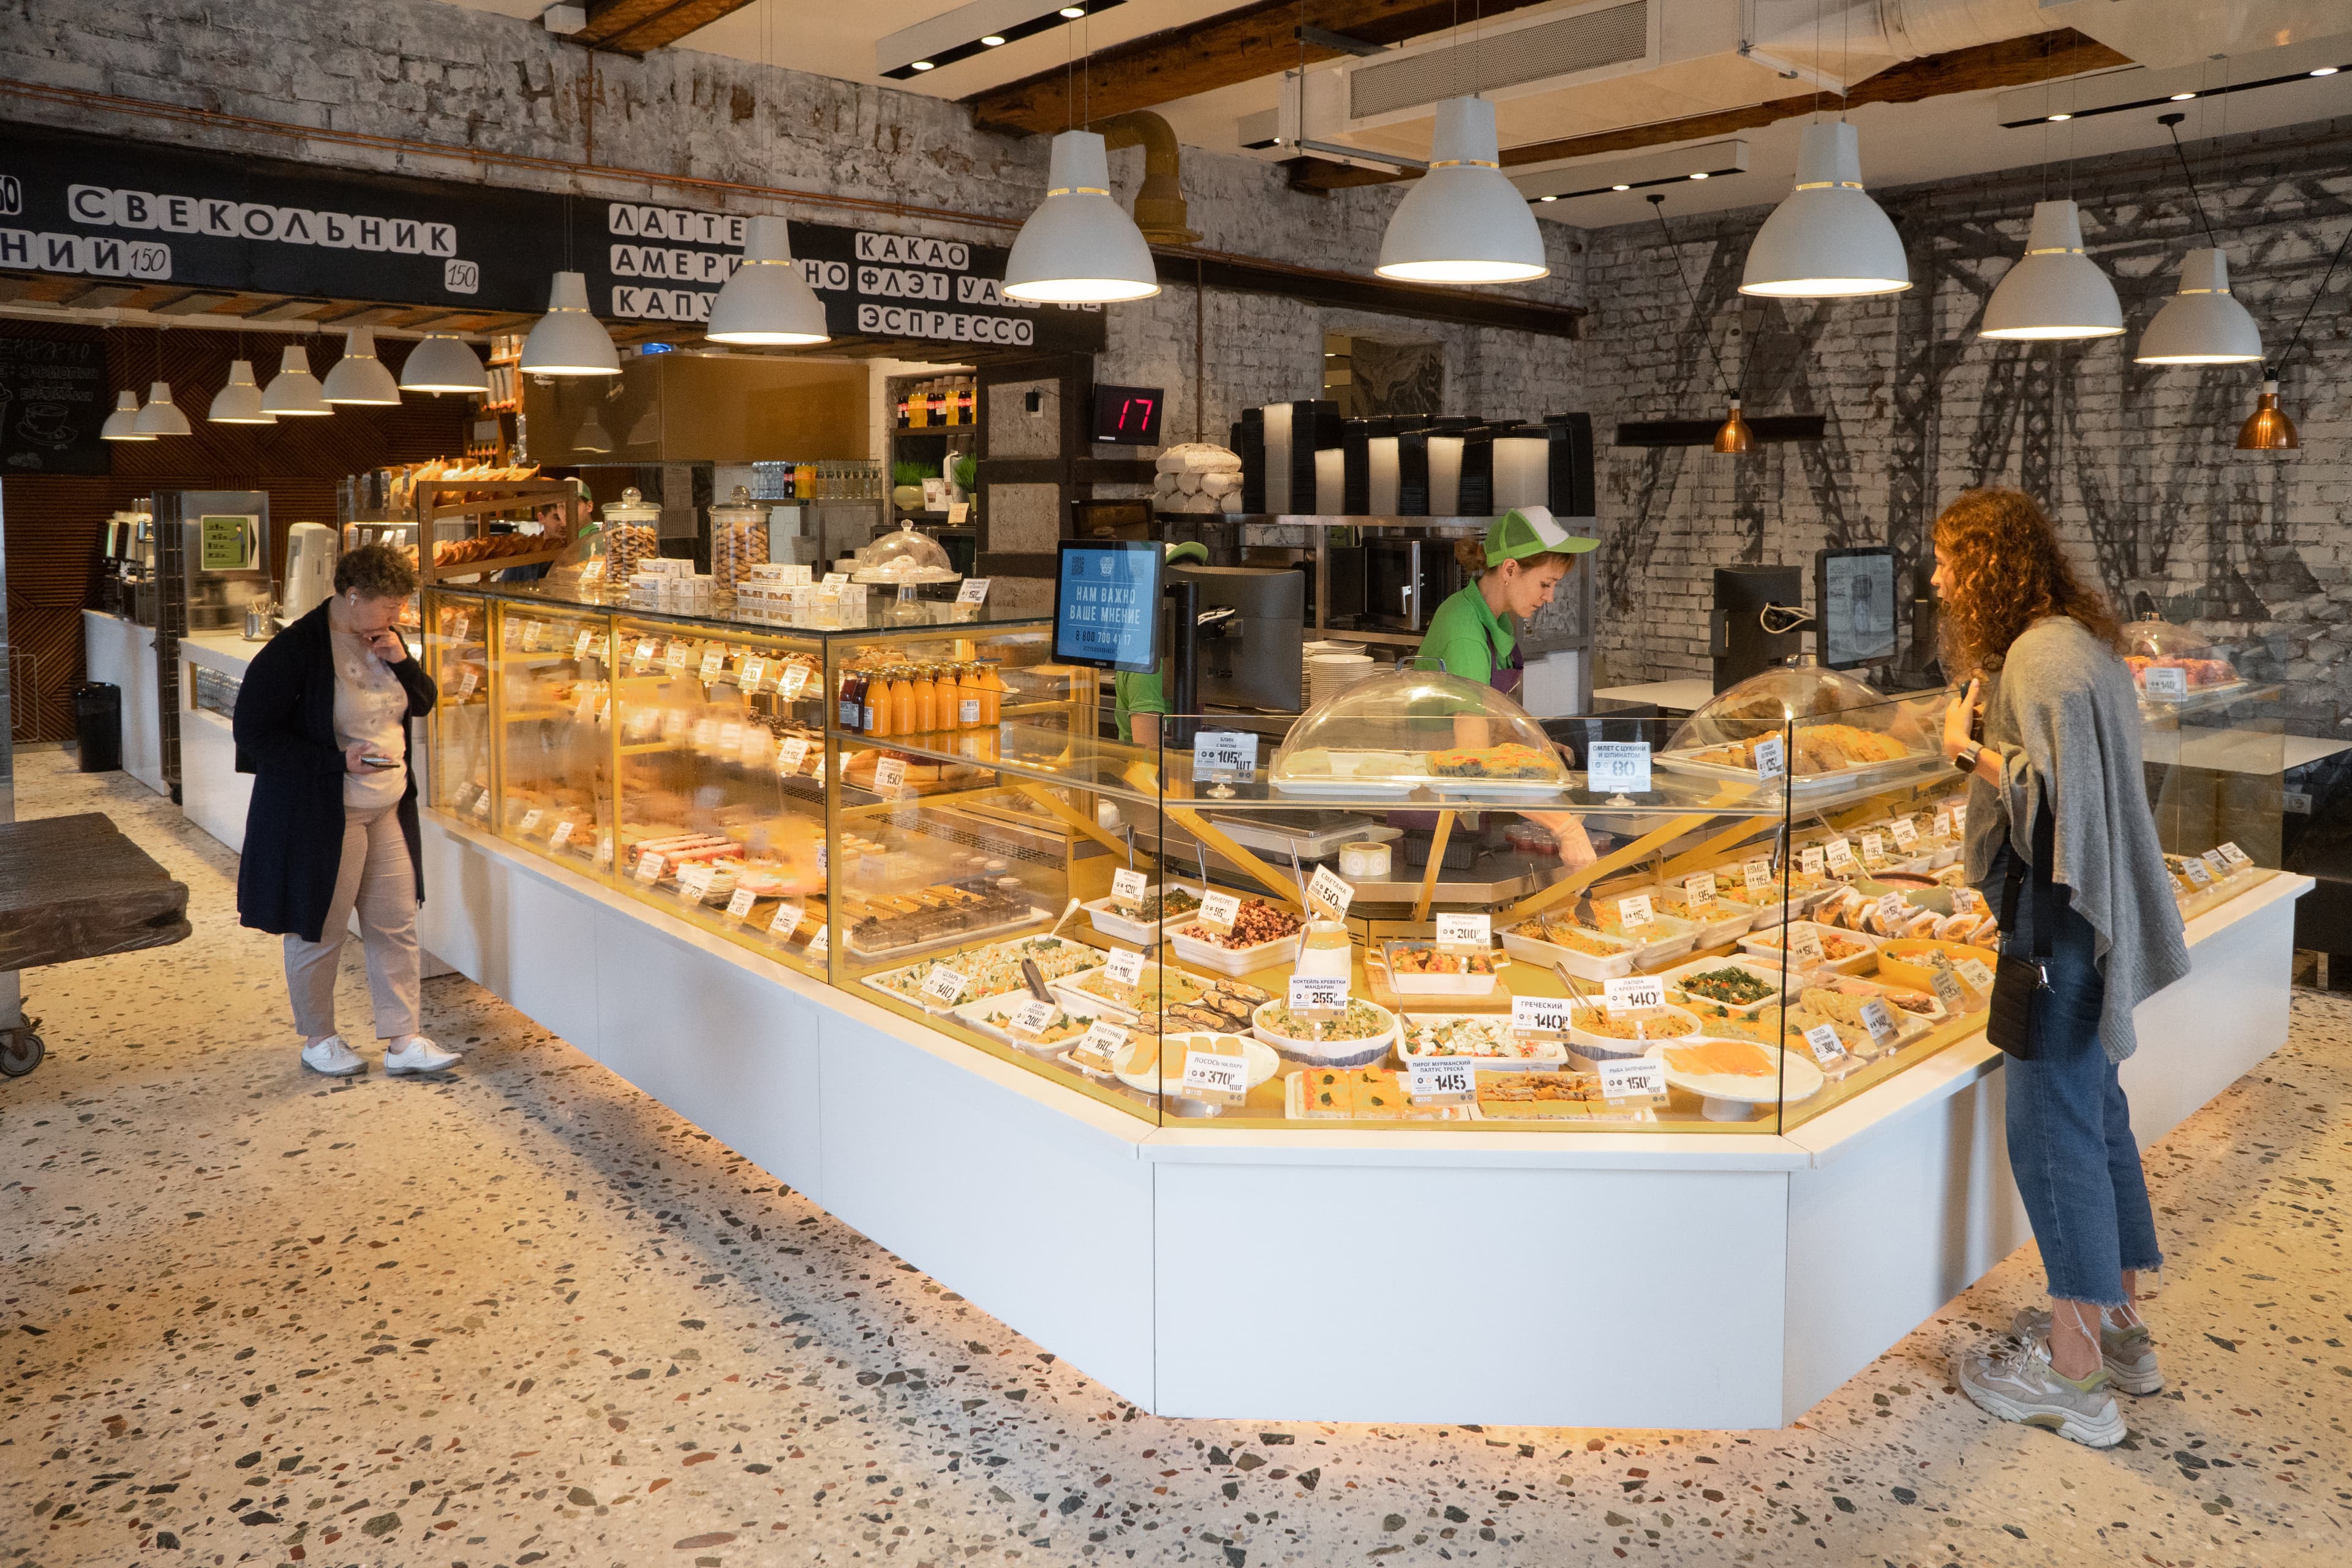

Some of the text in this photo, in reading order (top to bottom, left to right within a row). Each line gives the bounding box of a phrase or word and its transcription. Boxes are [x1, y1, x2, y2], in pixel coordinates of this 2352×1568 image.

[72, 188, 451, 254] СВЕКОЛЬНИК
[614, 208, 743, 241] ЛАТТЕ
[862, 233, 967, 267] КАКАО
[130, 247, 168, 273] 150
[614, 251, 846, 285] АМЕРИНО
[447, 265, 477, 287] 150
[861, 268, 943, 296] ФЛЭТ
[862, 306, 1031, 342] ЭСПРЕССО
[1118, 399, 1153, 431] 17
[1076, 586, 1136, 604] НАМ ВАЖНО
[1069, 605, 1140, 624] ВАШЕ МНЕНИЕ
[1076, 630, 1079, 641] 8
[1082, 631, 1095, 642] 800
[1098, 631, 1110, 644] 700
[1124, 634, 1131, 646] 17
[1218, 750, 1237, 764] 105
[1613, 761, 1635, 777] 80
[887, 773, 900, 785] 150
[1126, 884, 1135, 894] 120
[1320, 873, 1347, 894] СМЕТАНА
[1210, 895, 1232, 906] ВИНЕГРЕТ
[1322, 888, 1337, 906] 50
[1214, 907, 1224, 918] 95
[1457, 929, 1476, 939] 200
[942, 970, 959, 981] ЦЕЗАРЬ
[937, 983, 955, 998] 140
[1312, 992, 1333, 1004] 255
[1521, 1001, 1562, 1009] ГРЕЧЕСКИЙ
[1628, 992, 1656, 1006] 140
[1534, 1013, 1562, 1029] 140
[1107, 1030, 1122, 1039] ТУНЕЦ
[1194, 1057, 1220, 1066] ЛОСОСЬ
[1208, 1071, 1231, 1085] 370
[1436, 1074, 1466, 1090] 145
[1627, 1077, 1646, 1090] 150
